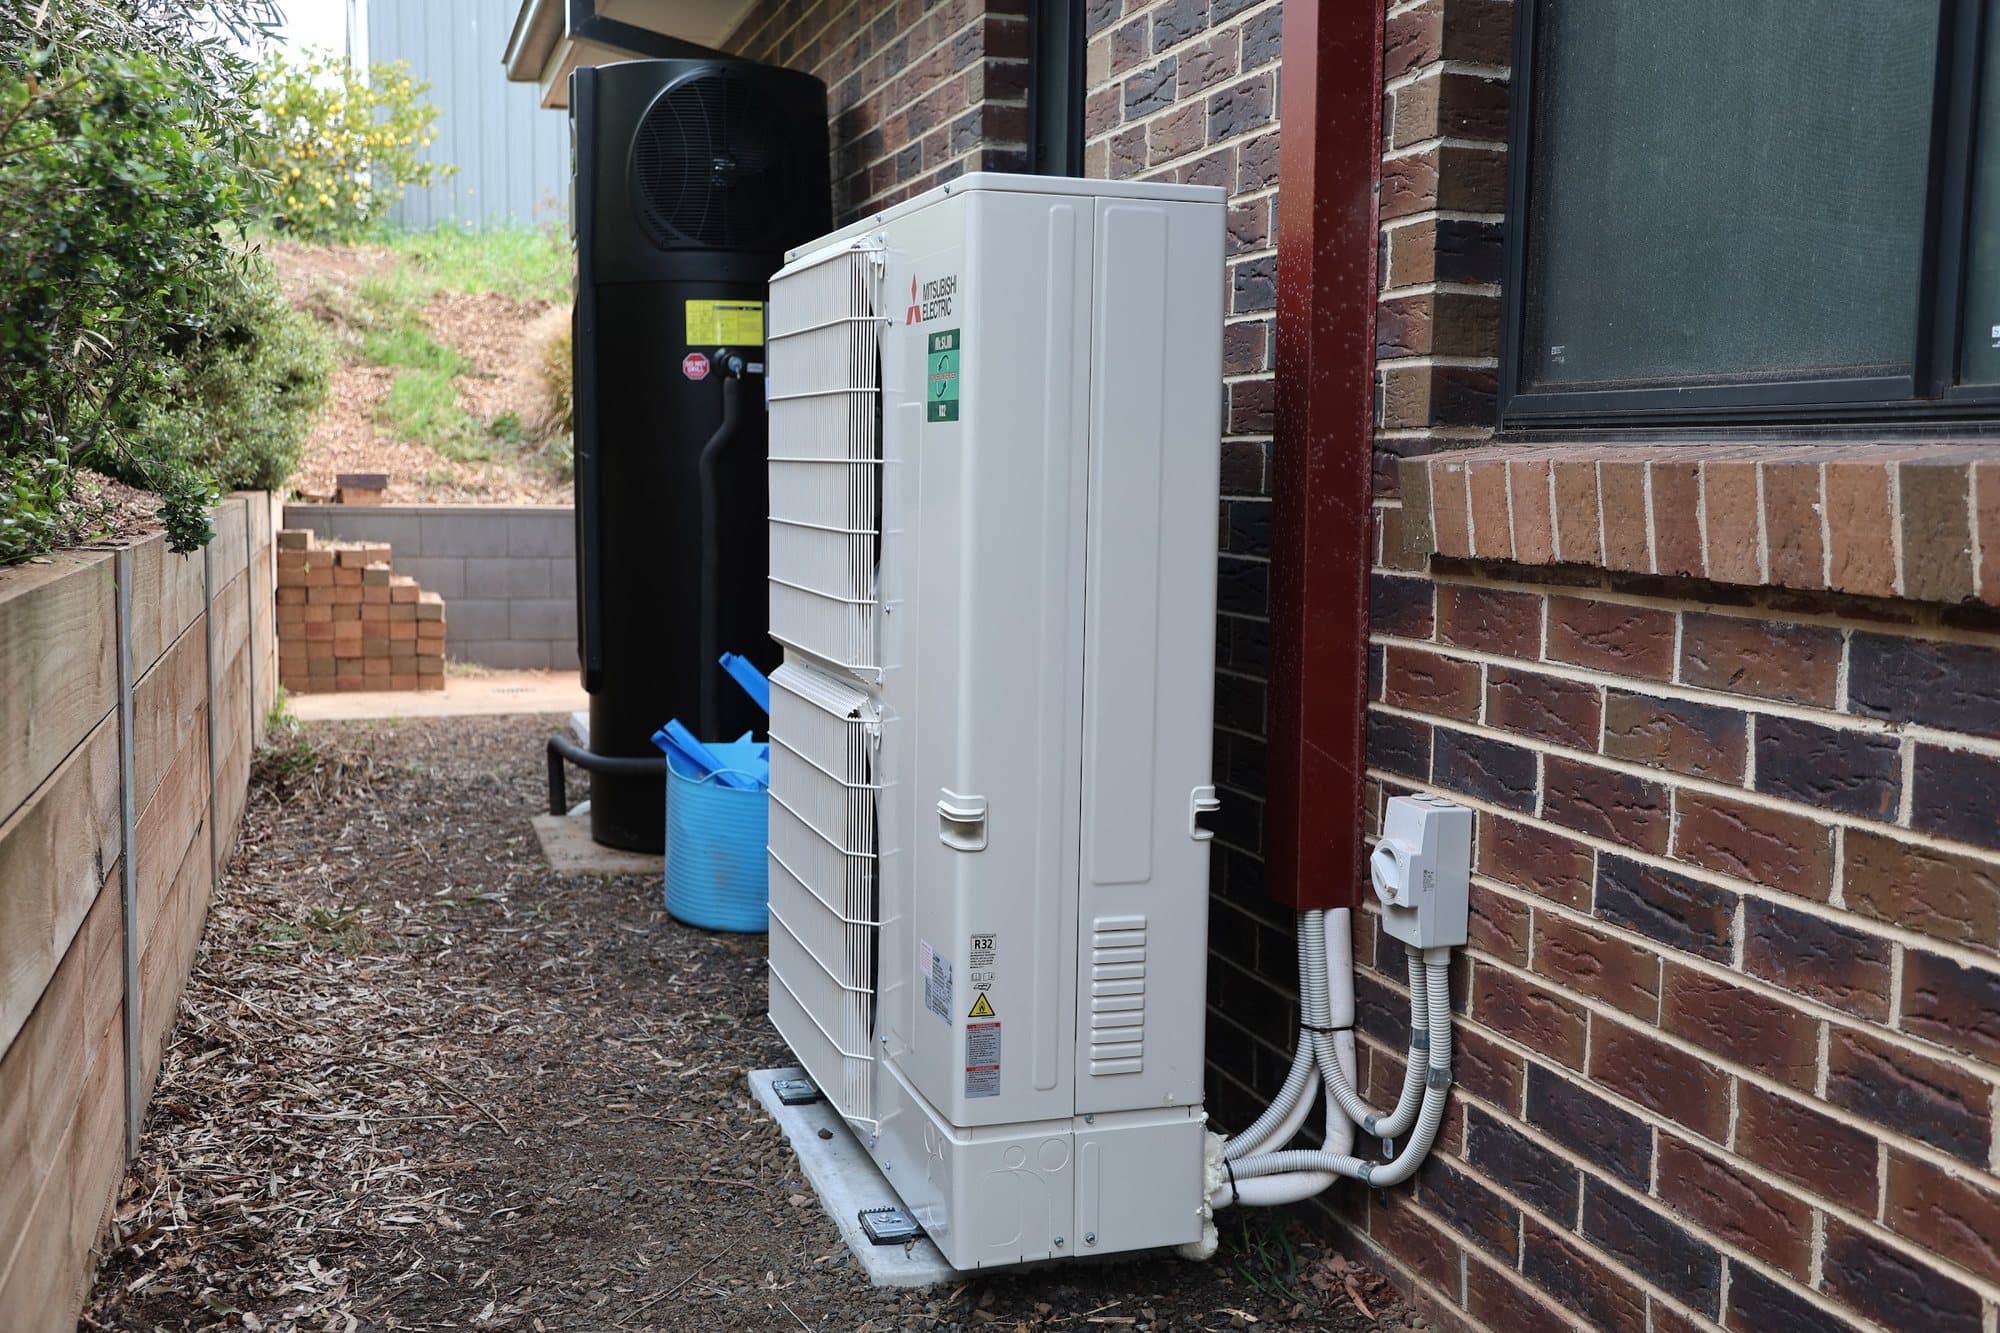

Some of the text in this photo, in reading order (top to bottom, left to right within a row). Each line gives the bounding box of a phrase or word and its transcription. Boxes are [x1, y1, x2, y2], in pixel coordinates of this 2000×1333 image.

[923, 275, 957, 301] MITSUBISHI
[922, 297, 951, 321] ELECTRIC
[974, 938, 993, 950] R32
